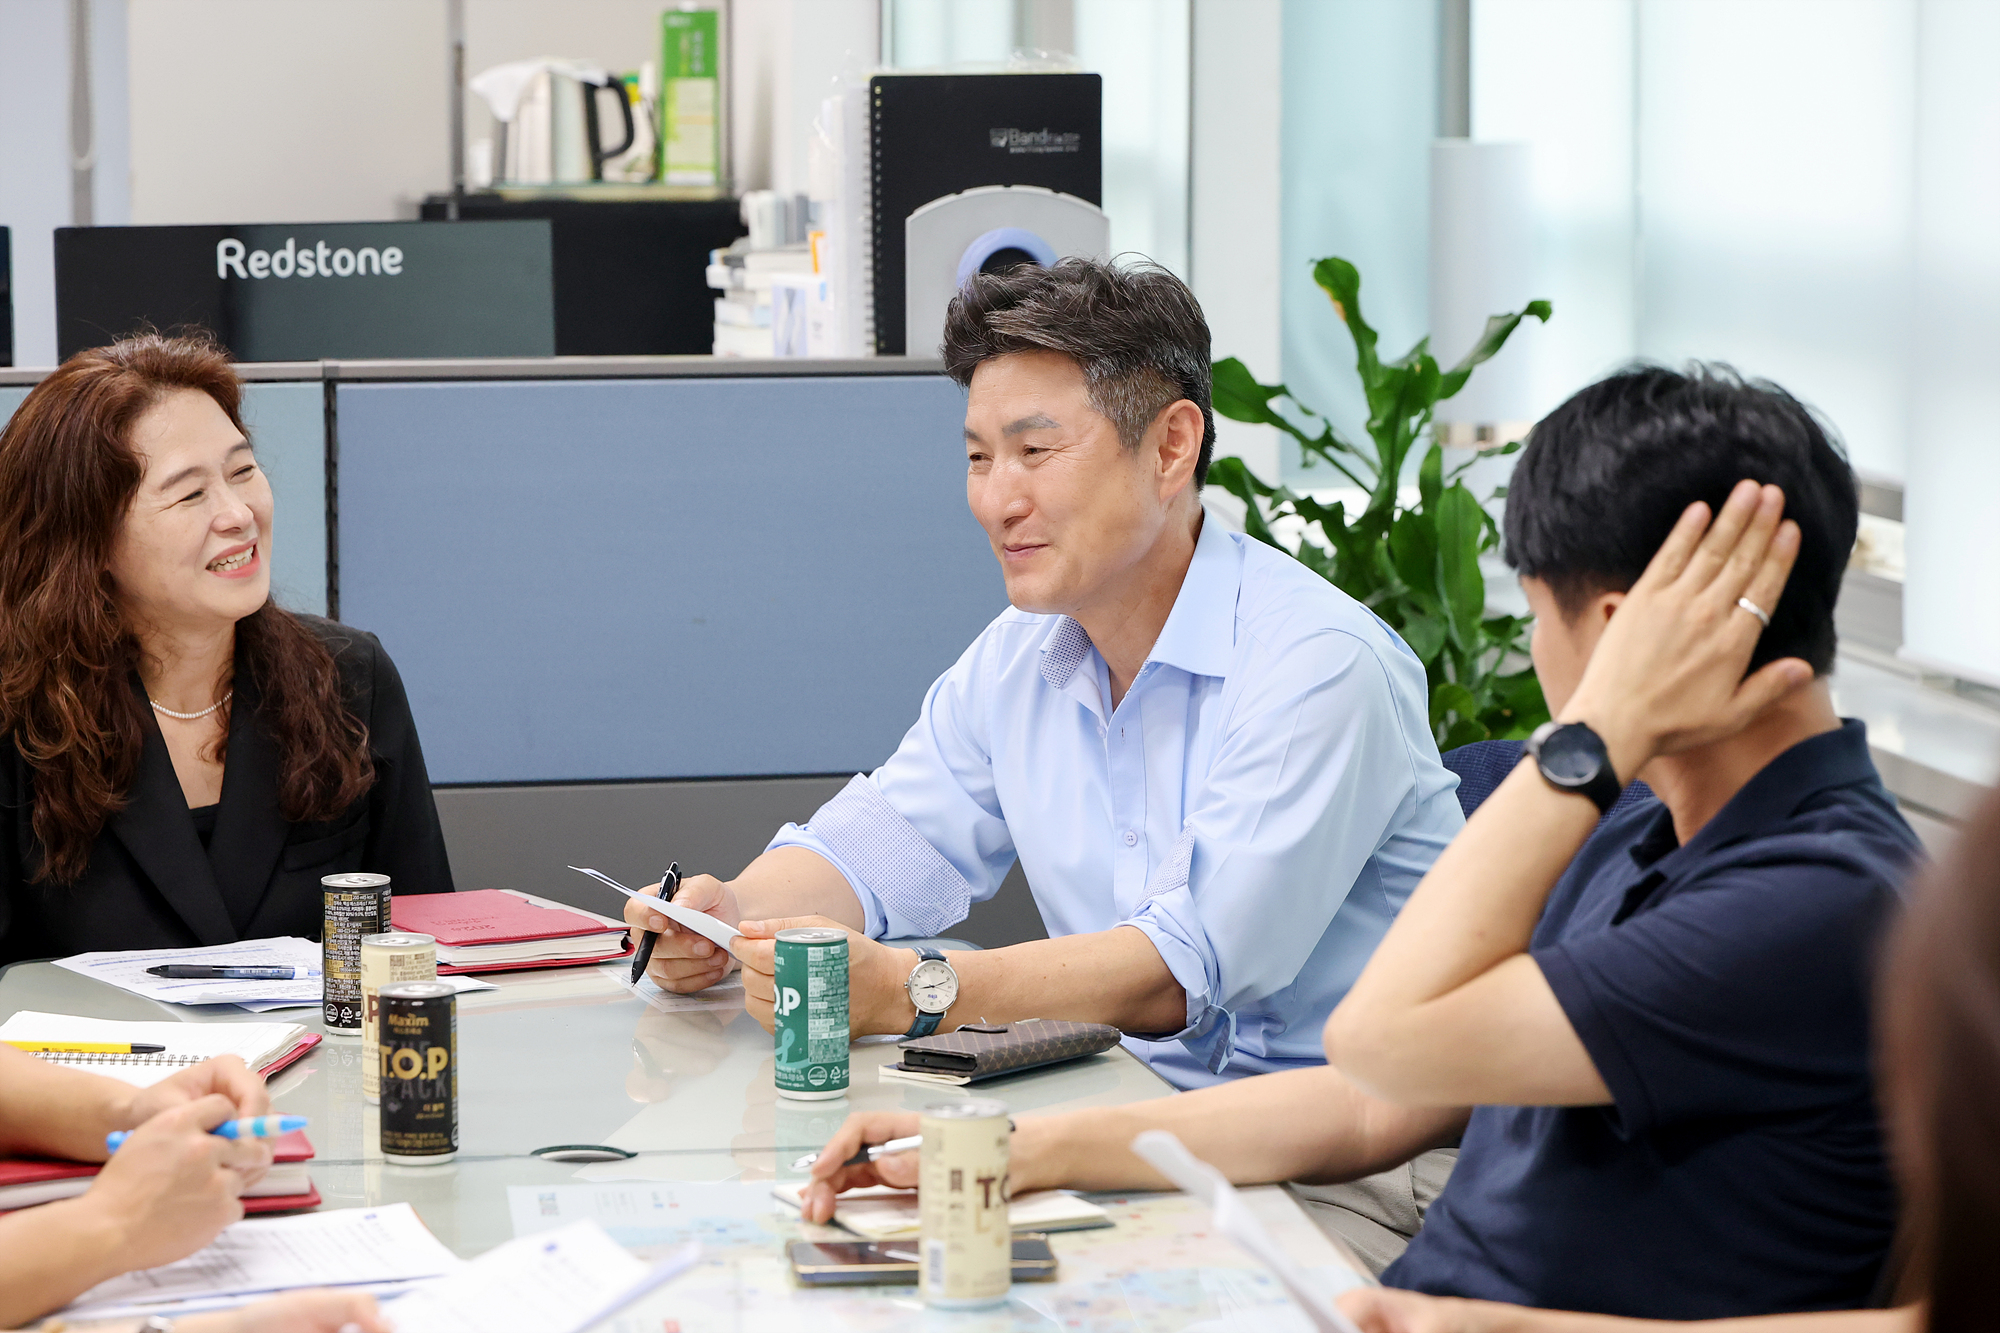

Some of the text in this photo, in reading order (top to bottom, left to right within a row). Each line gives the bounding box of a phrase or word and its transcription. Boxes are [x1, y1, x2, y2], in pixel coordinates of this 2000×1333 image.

[216, 237, 404, 280] Redstone
[388, 1013, 430, 1027] Maxim
[380, 1044, 449, 1080] T.O.P
